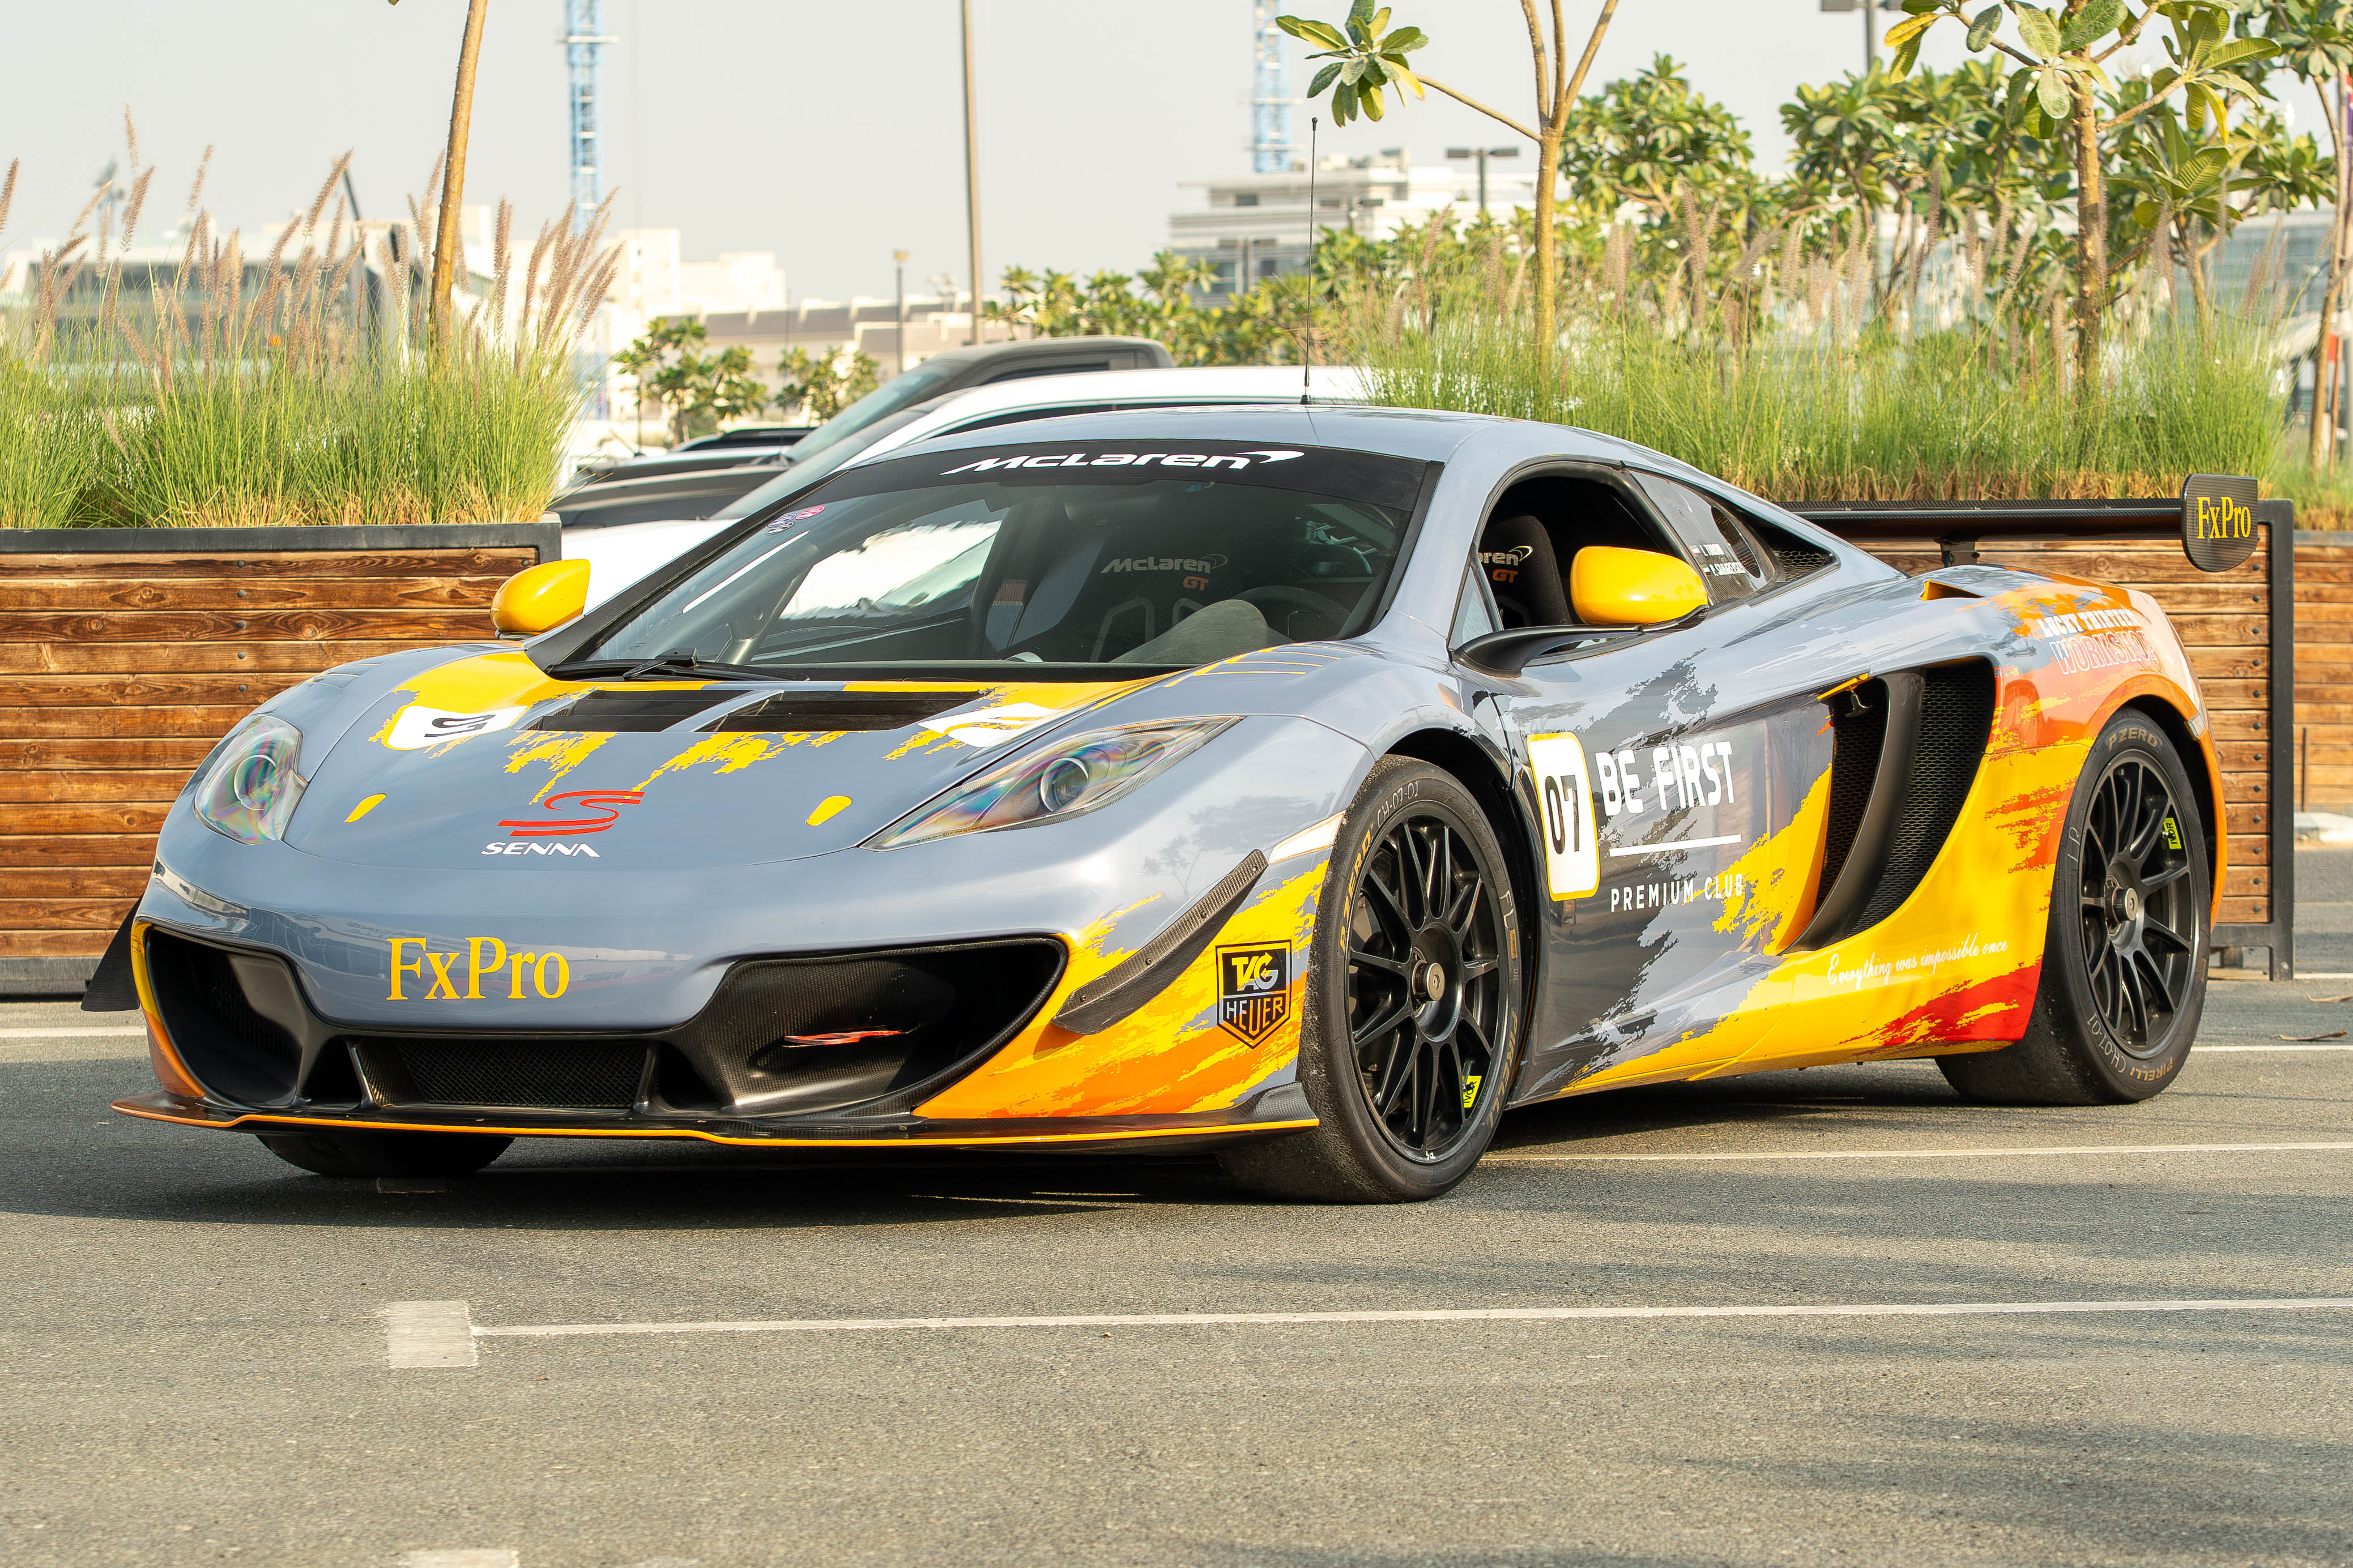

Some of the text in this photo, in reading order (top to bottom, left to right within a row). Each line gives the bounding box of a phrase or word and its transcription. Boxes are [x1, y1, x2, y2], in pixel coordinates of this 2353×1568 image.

[939, 453, 1251, 476] McLaren
[2196, 496, 2252, 539] FxPro
[1100, 557, 1210, 574] McLaren
[1183, 576, 1209, 591] GT
[1493, 569, 1519, 583] GT
[2037, 609, 2140, 638] LUCKY THIRTEEN
[2049, 630, 2158, 675] WORKSHOP
[1595, 741, 1735, 817] BE FIRST
[1545, 774, 1580, 855] 07
[480, 841, 601, 858] SENNA
[1610, 873, 1744, 912] PREMIUM CLUB
[386, 937, 570, 1001] FxPro
[1231, 951, 1279, 992] TAG
[1827, 932, 2008, 990] Everything was impossible once
[1226, 996, 1284, 1037] HEUER
[1489, 1010, 1518, 1129] PIRELLI
[2129, 1057, 2173, 1082] PIRELLI
